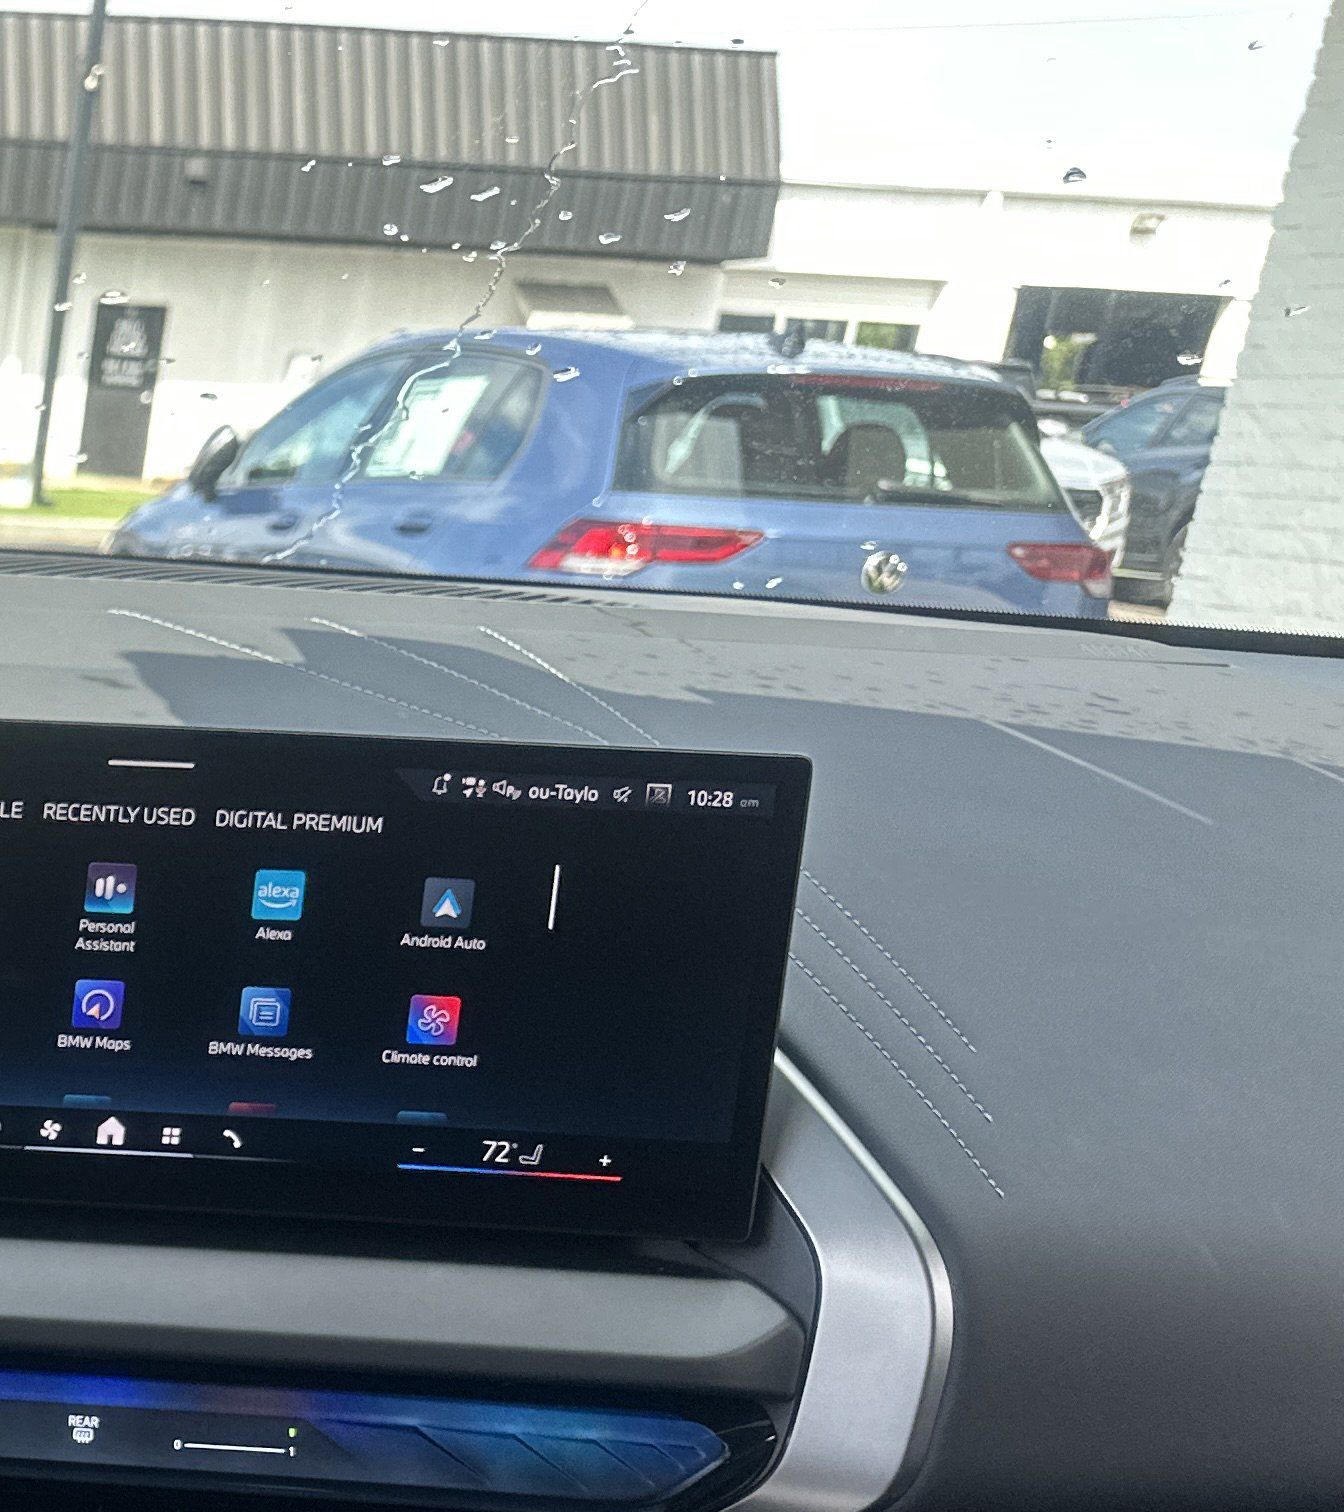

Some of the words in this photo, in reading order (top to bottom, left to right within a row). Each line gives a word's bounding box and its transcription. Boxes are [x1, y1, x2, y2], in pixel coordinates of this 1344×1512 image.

[528, 784, 599, 803] ou-Taylo
[687, 789, 734, 808] 10:28
[740, 797, 759, 808] am
[43, 803, 140, 824] RECENTLY
[143, 806, 196, 826] USED
[215, 809, 287, 830] DIGITAL
[292, 813, 383, 834] PREMIUM
[257, 881, 300, 899] alexa
[78, 919, 135, 935] Personal
[255, 926, 292, 942] Alexa
[74, 937, 136, 953] Assistant
[400, 932, 452, 950] Android
[454, 935, 486, 951] Auto
[57, 1034, 93, 1050] BMW
[94, 1036, 132, 1053] Maps
[208, 1041, 245, 1056] BMW
[246, 1043, 313, 1061] Messages
[381, 1049, 430, 1066] Climate
[432, 1051, 478, 1068] control
[68, 1414, 100, 1428] REAR
